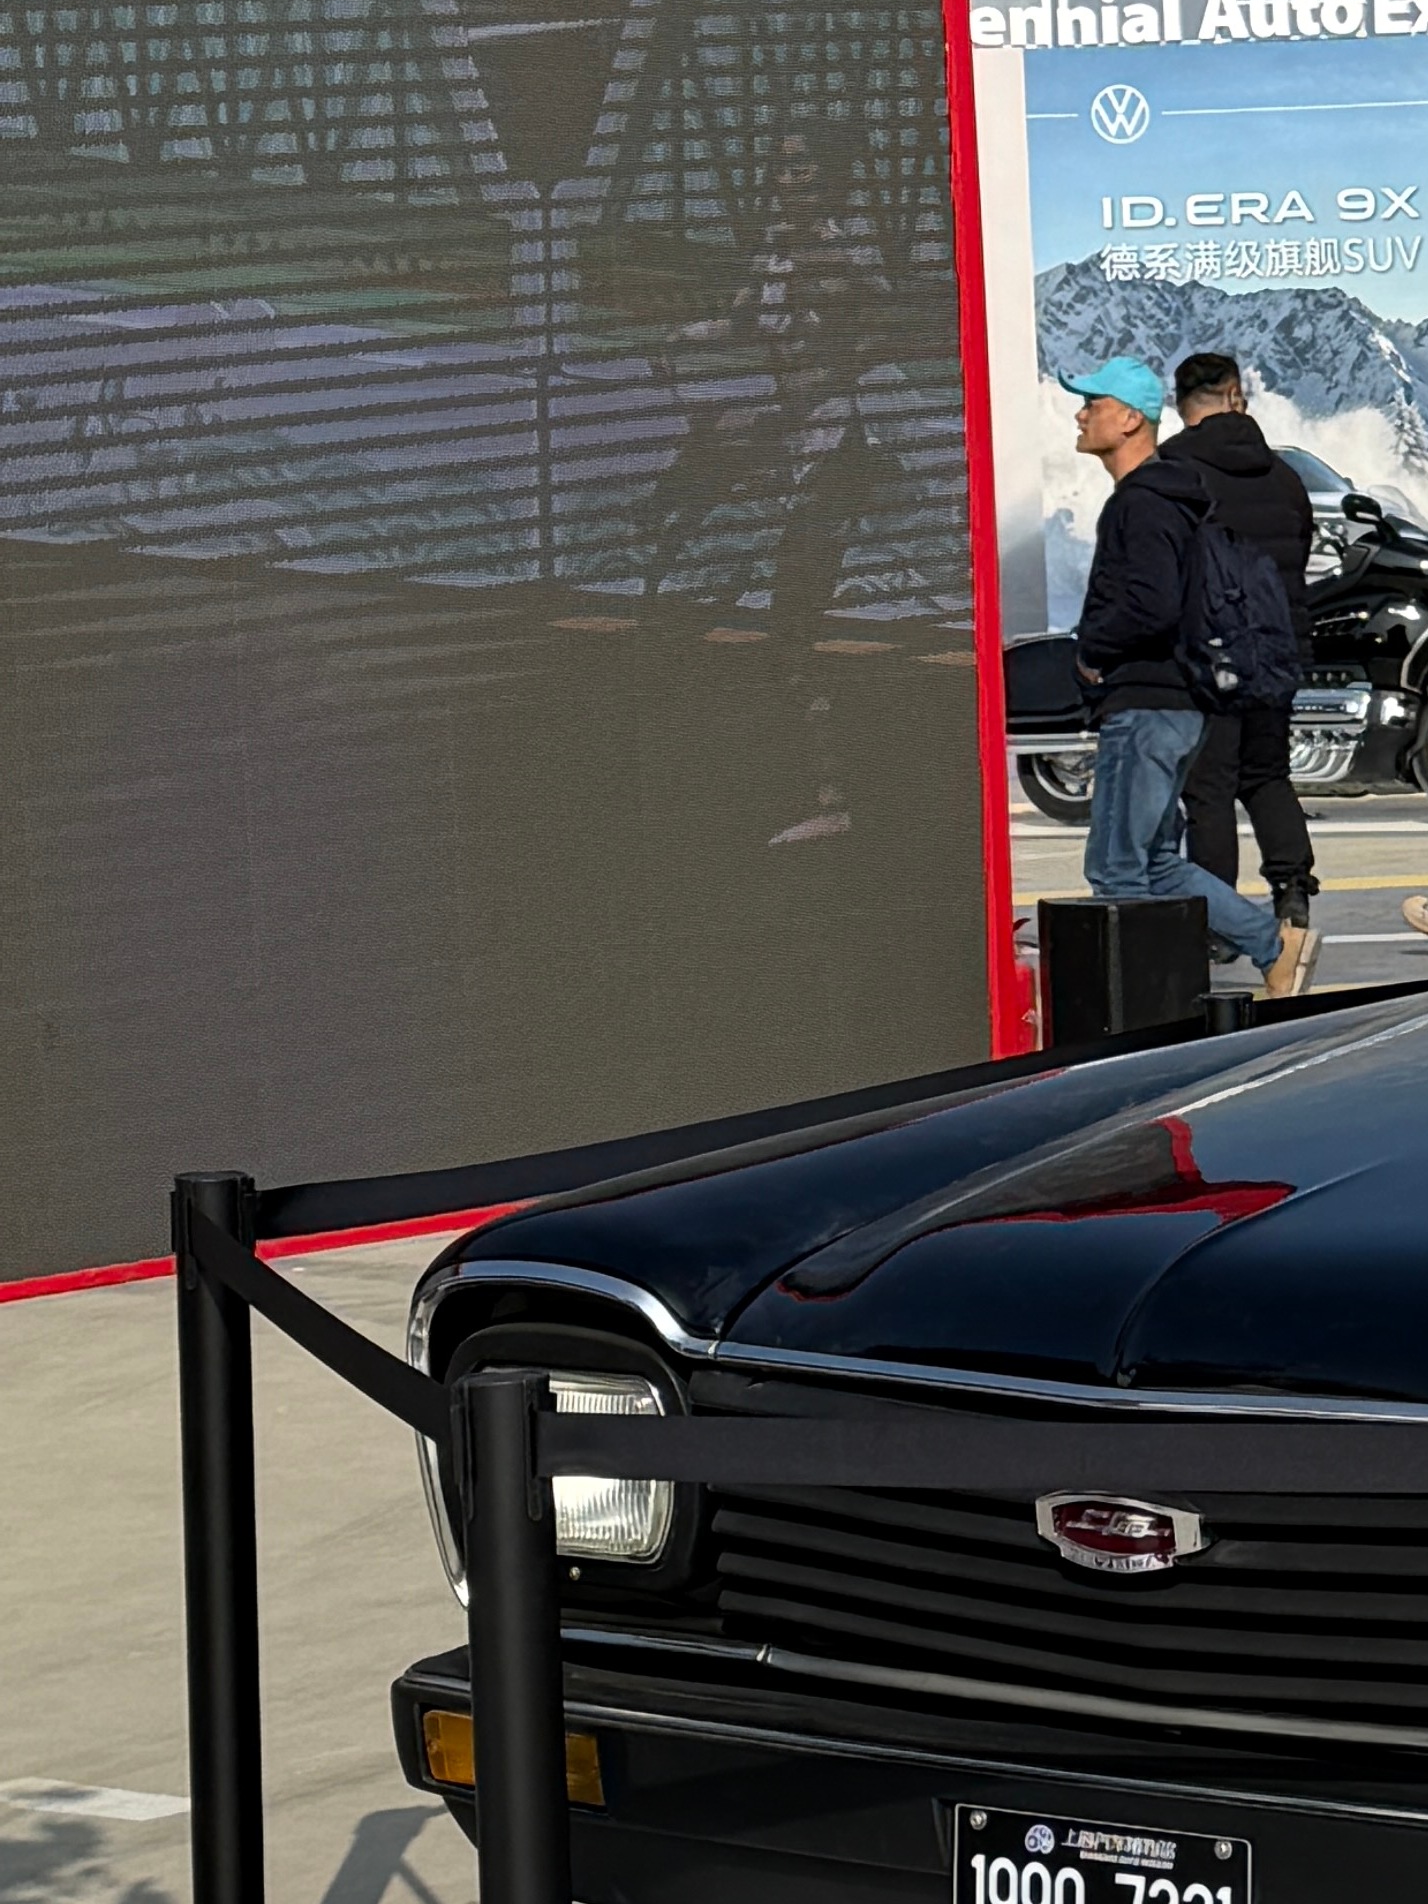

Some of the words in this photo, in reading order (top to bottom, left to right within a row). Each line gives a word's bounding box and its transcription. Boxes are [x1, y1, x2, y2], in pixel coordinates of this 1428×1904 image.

[1101, 190, 1315, 229] ID.ERA
[1336, 185, 1421, 221] 9X
[1100, 235, 1423, 283] 德系满级旗舰SUV
